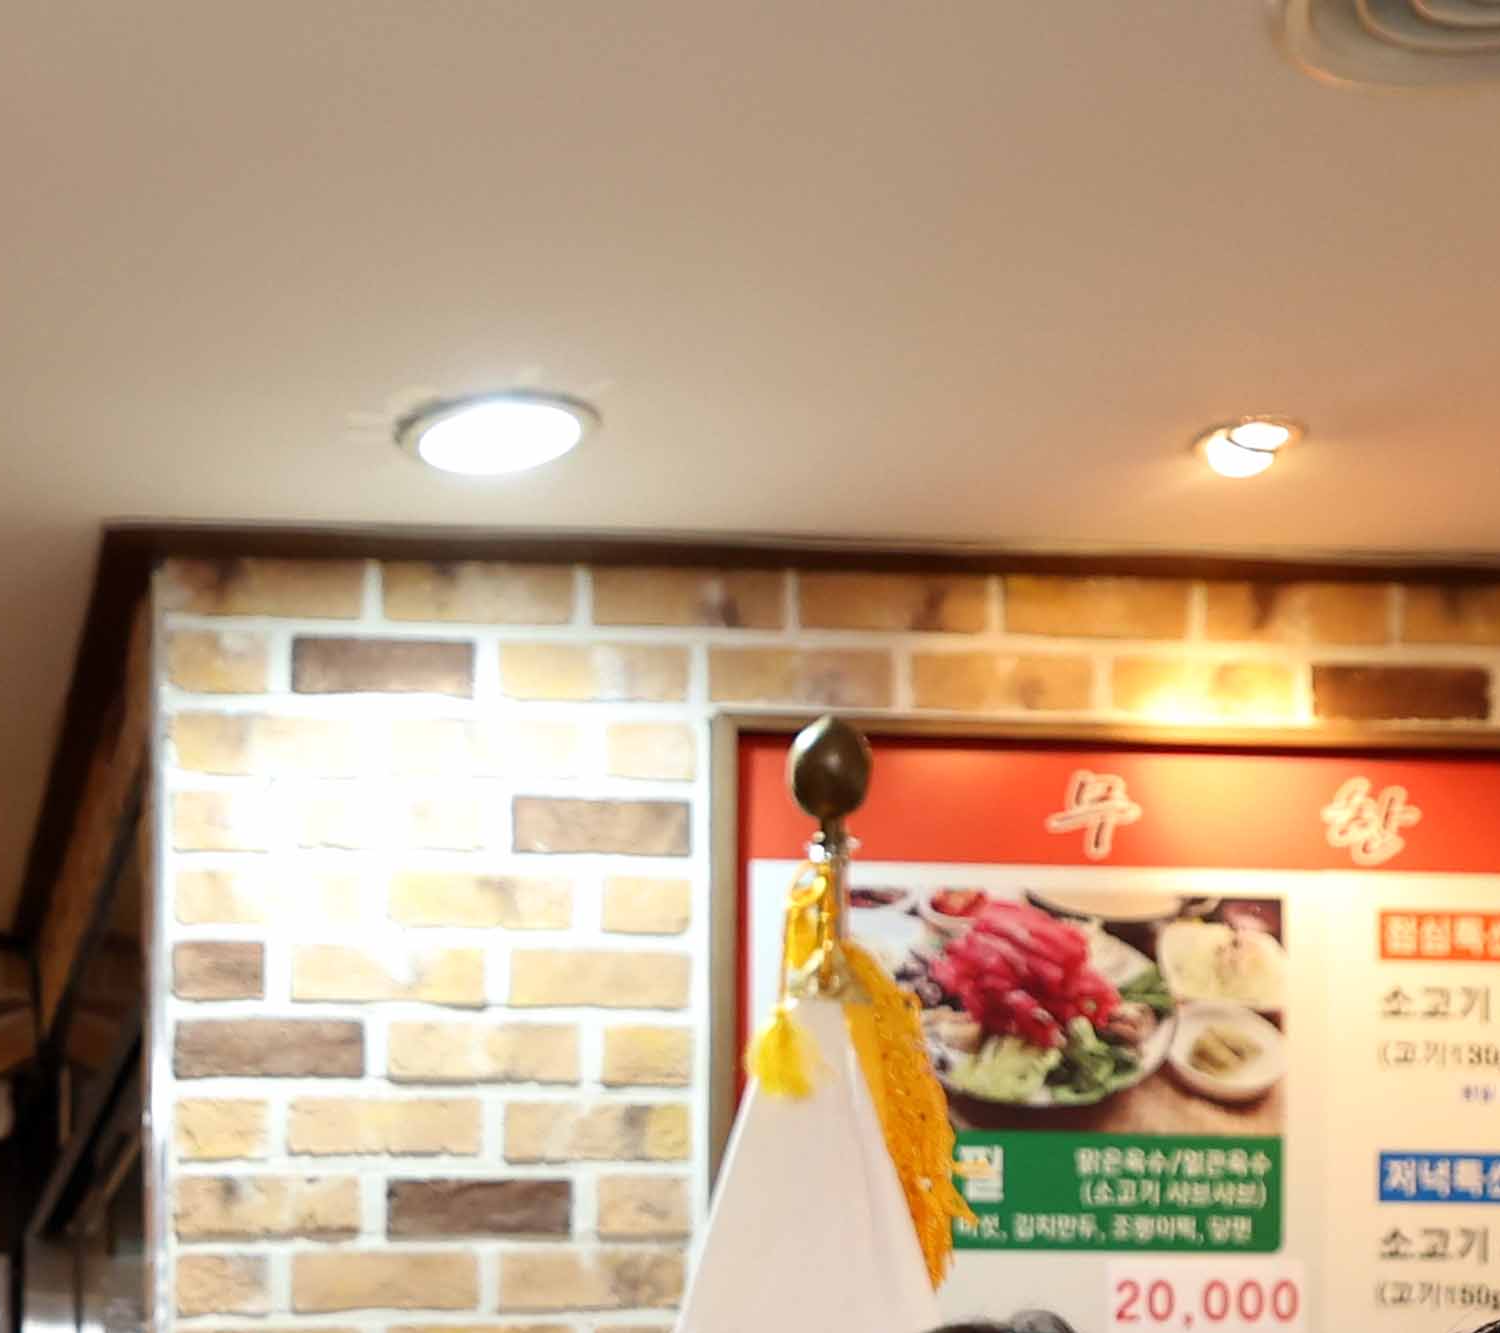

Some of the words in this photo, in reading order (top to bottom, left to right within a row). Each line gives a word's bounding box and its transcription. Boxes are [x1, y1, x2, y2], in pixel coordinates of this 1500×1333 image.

[1381, 985, 1491, 1022] 소고기
[1379, 1226, 1489, 1263] 소고기
[1115, 1280, 1300, 1331] 20,000
